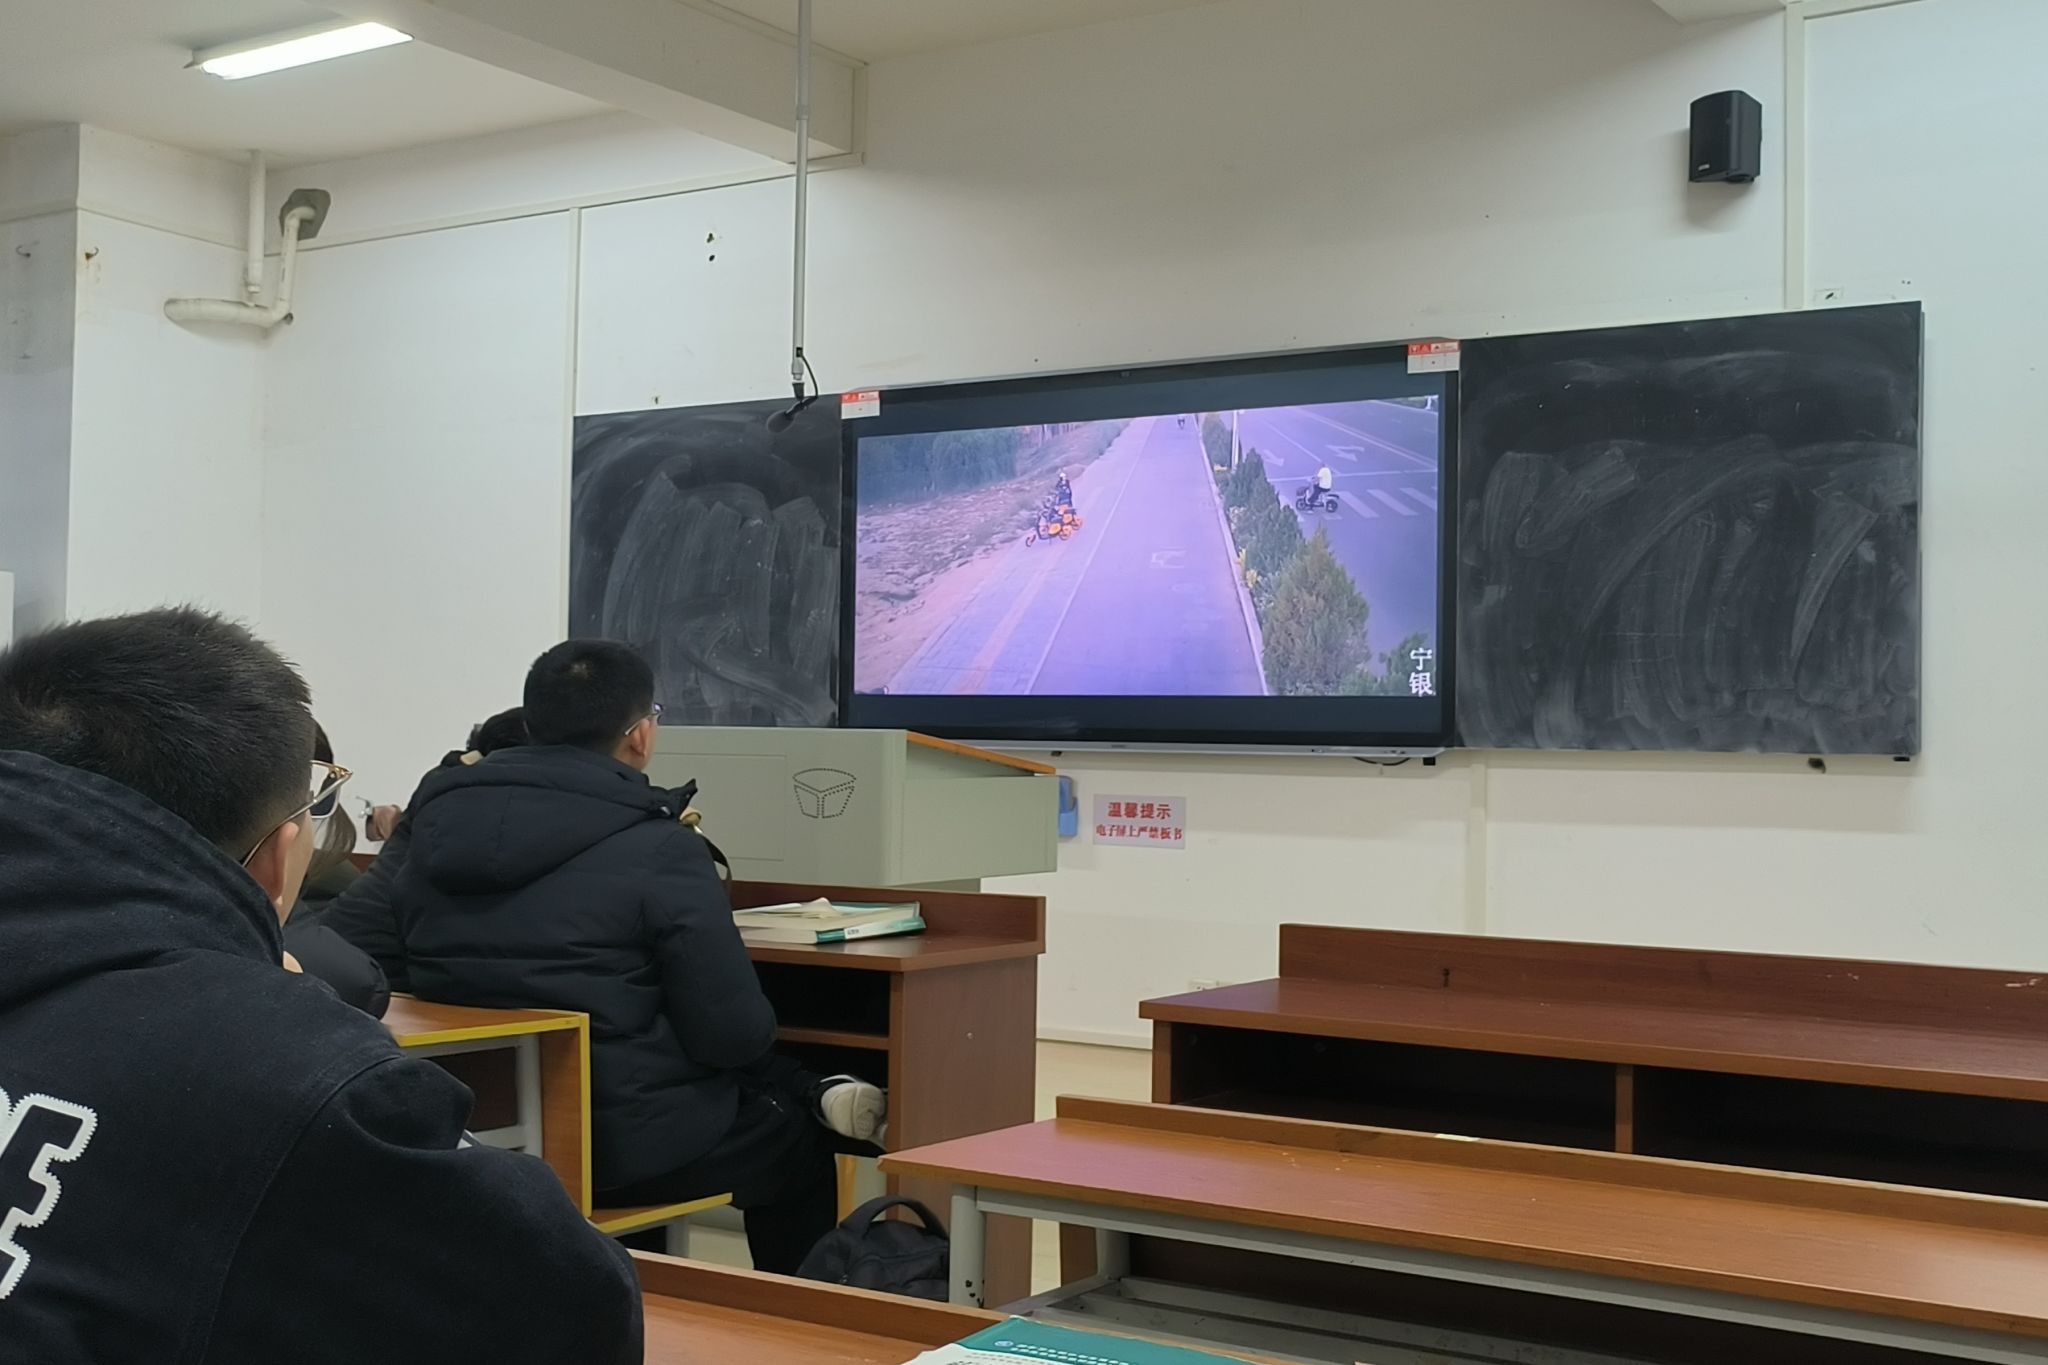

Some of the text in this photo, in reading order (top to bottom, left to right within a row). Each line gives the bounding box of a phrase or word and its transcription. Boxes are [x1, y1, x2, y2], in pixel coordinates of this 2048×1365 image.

[1409, 647, 1433, 697] 宁银
[1107, 802, 1172, 820] 温馨提示
[1096, 824, 1183, 841] 电子屏上严禁板书
